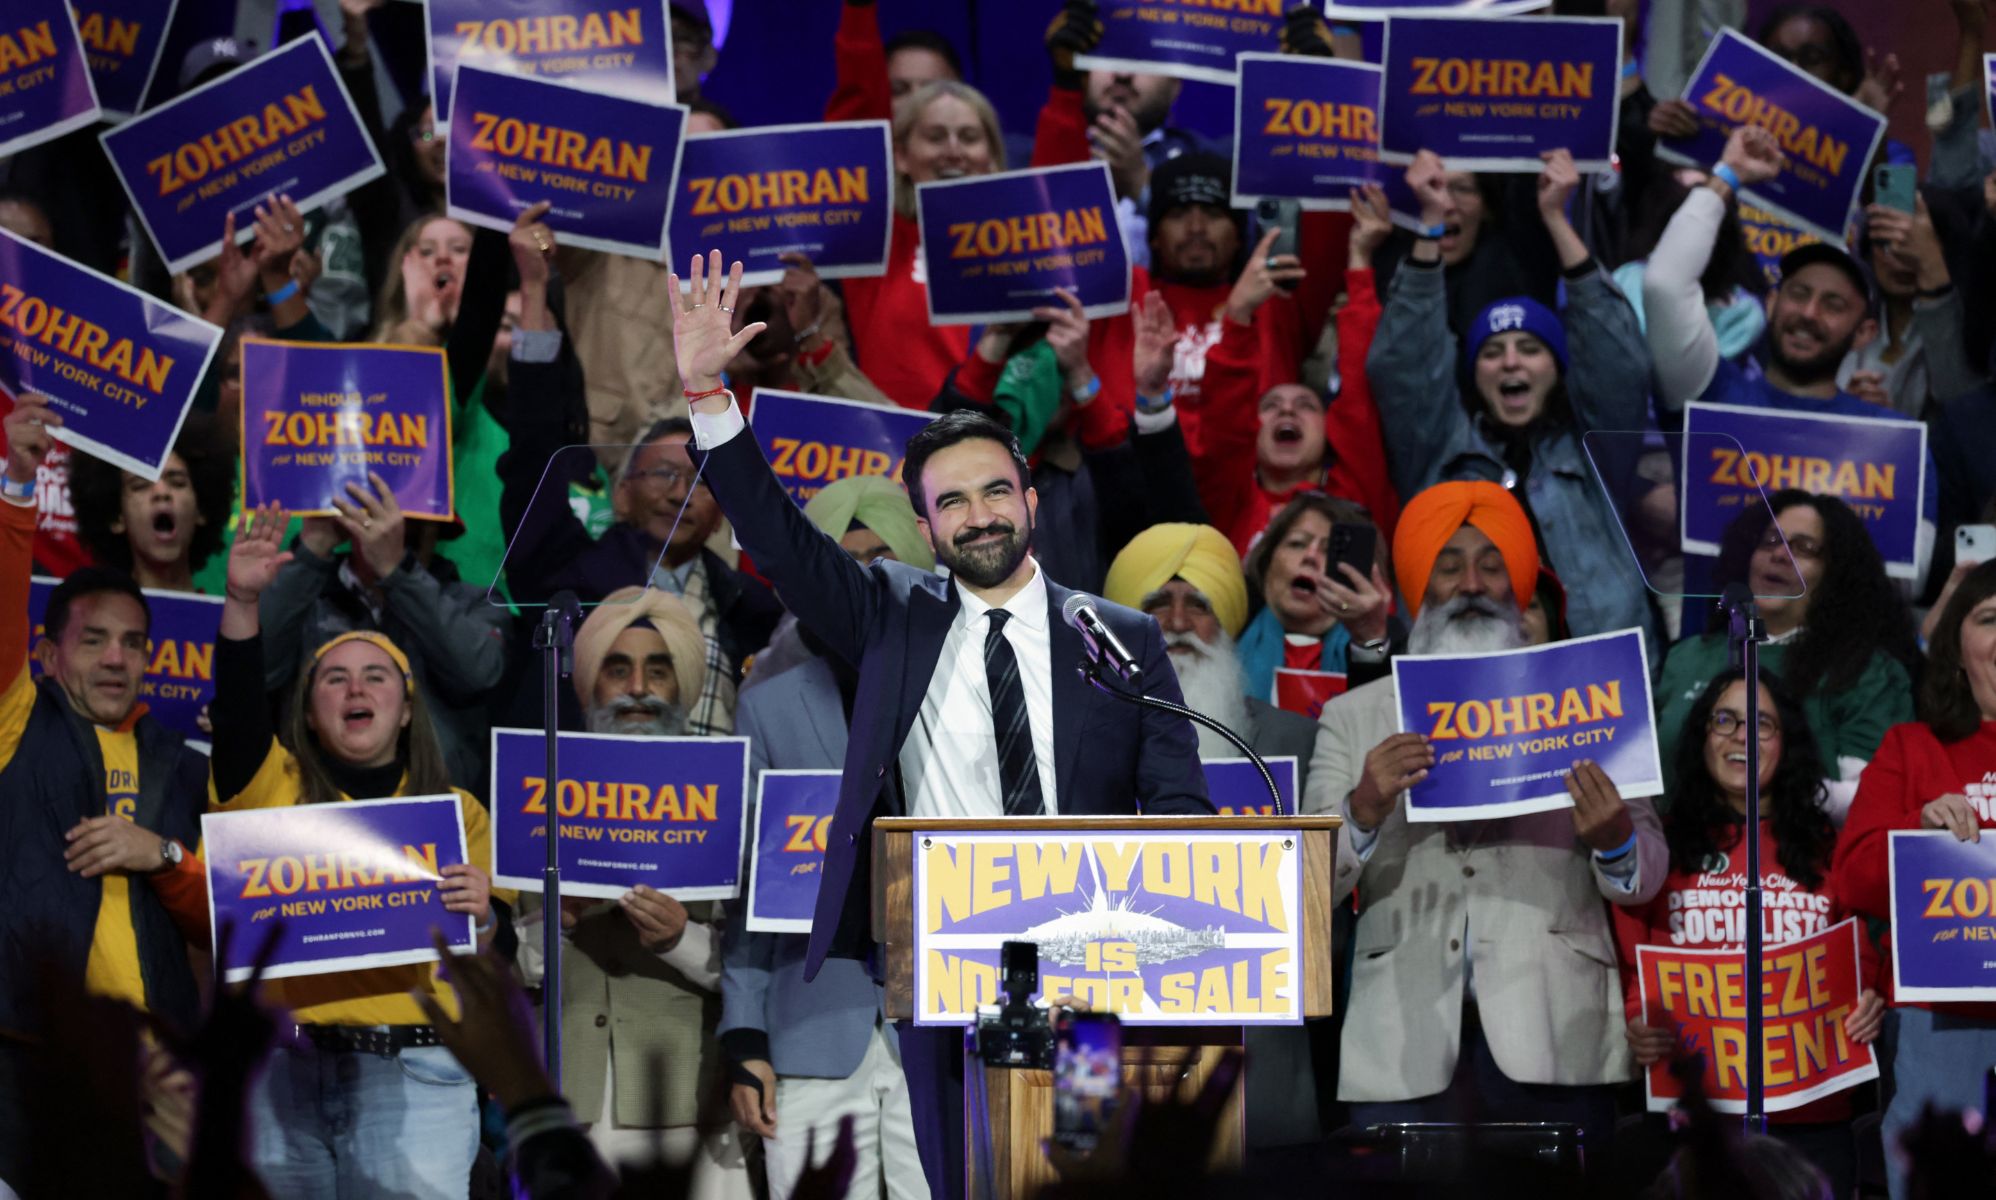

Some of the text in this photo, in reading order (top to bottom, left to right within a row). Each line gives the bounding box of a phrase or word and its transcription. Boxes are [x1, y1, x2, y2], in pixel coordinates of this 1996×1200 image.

[455, 8, 643, 55] ZOHRAN
[1410, 57, 1594, 98] ZOHRAN
[1444, 101, 1486, 117] NEW
[1490, 103, 1536, 118] YORK
[1539, 103, 1581, 119] CITY
[1702, 73, 1848, 176] ZOHRAN
[147, 83, 327, 197] ZOHRAN
[471, 111, 653, 182] ZOHRAN
[198, 172, 238, 200] NEW
[239, 148, 288, 179] YORK
[288, 128, 326, 158] CITY
[498, 163, 537, 183] NEW
[541, 171, 589, 194] YORK
[592, 182, 636, 202] CITY
[688, 166, 869, 217] ZOHRAN
[728, 216, 771, 234] NEW
[774, 211, 820, 228] YORK
[824, 209, 862, 225] CITY
[948, 206, 1108, 259] ZOHRAN
[988, 260, 1030, 277] NEW
[1033, 253, 1074, 272] YORK
[0, 283, 176, 395] ZOHRAN
[13, 340, 50, 368] NEW
[53, 358, 102, 392] YORK
[103, 383, 148, 411] CITY
[264, 410, 427, 448] ZOHRAN
[295, 453, 335, 466] NEW
[340, 452, 384, 465] YORK
[387, 453, 421, 467] CITY
[1710, 448, 1895, 500] ZOHRAN
[160, 684, 202, 701] CITY
[1426, 679, 1624, 740] ZOHRAN
[1468, 743, 1514, 761] NEW
[1518, 734, 1568, 756] YORK
[1572, 726, 1616, 747] CITY
[522, 776, 719, 822] ZOHRAN
[559, 824, 603, 841] NEW
[608, 828, 659, 843] YORK
[663, 829, 707, 844] CITY
[237, 843, 440, 899] ZOHRAN
[926, 841, 1289, 934] NEW YORK
[1697, 872, 1798, 892] New Yo City
[281, 900, 327, 917] NEW
[331, 895, 383, 913] YORK
[387, 889, 432, 907] CITY
[1921, 877, 1996, 919] ZO
[927, 947, 1291, 1014] NO FOR SALE
[1085, 942, 1137, 972] IS
[1657, 944, 1831, 1020] FREEZE
[1711, 1004, 1851, 1090] RENT
